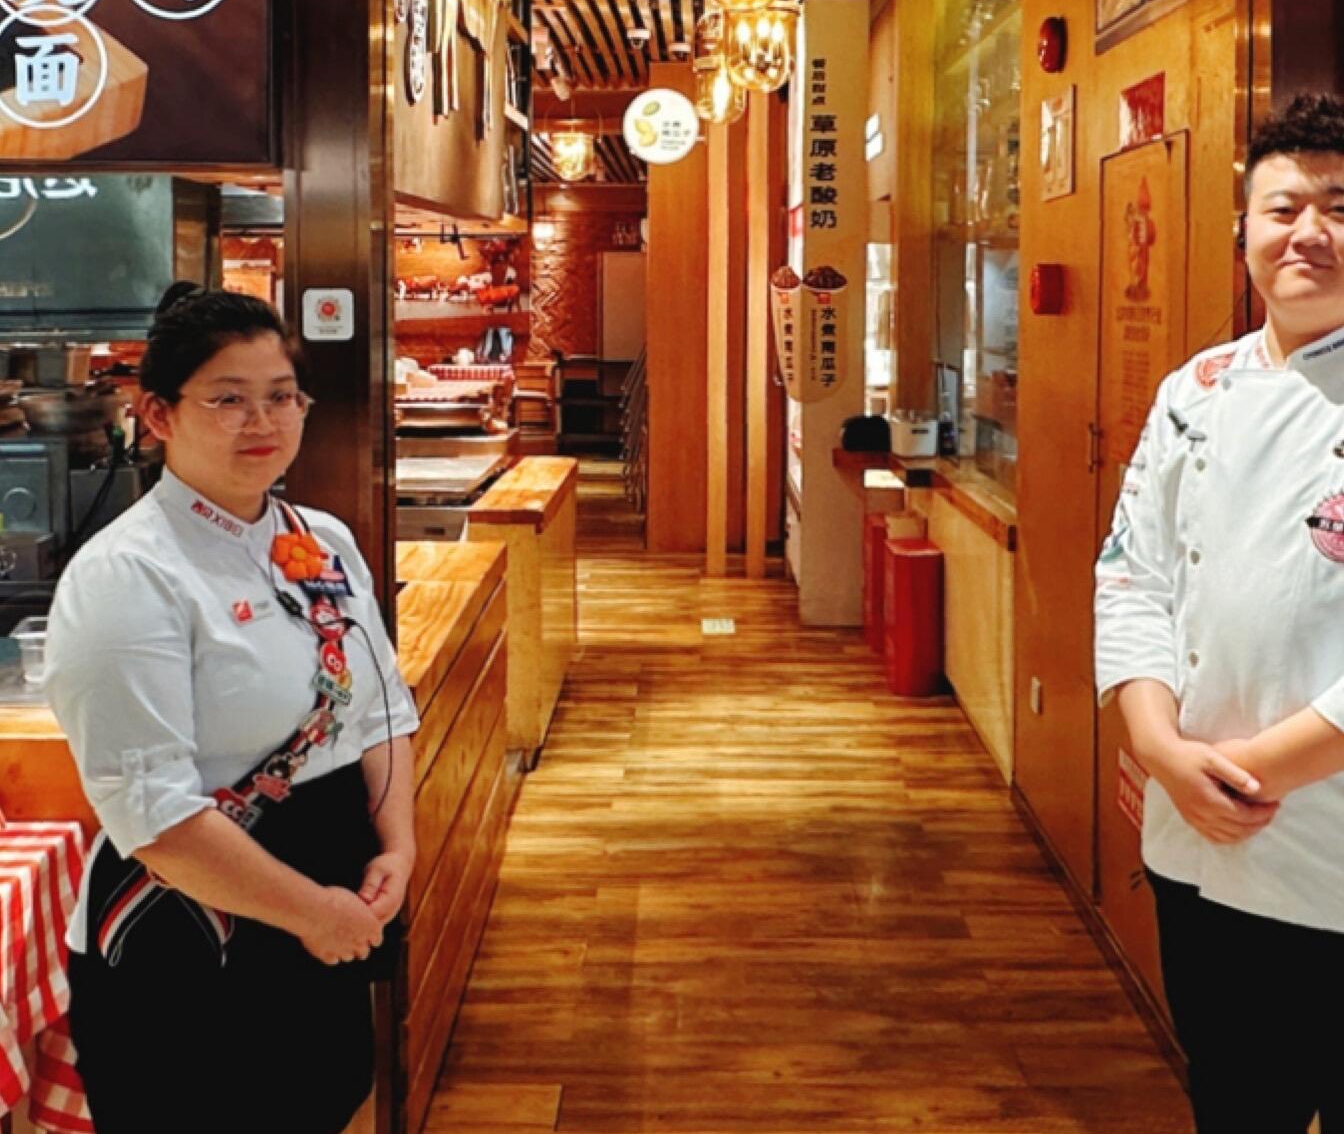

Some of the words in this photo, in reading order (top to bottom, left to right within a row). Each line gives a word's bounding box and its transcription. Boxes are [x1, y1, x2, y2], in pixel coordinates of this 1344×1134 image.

[809, 114, 838, 228] 草原老酸奶
[820, 307, 837, 388] 水煮南瓜子
